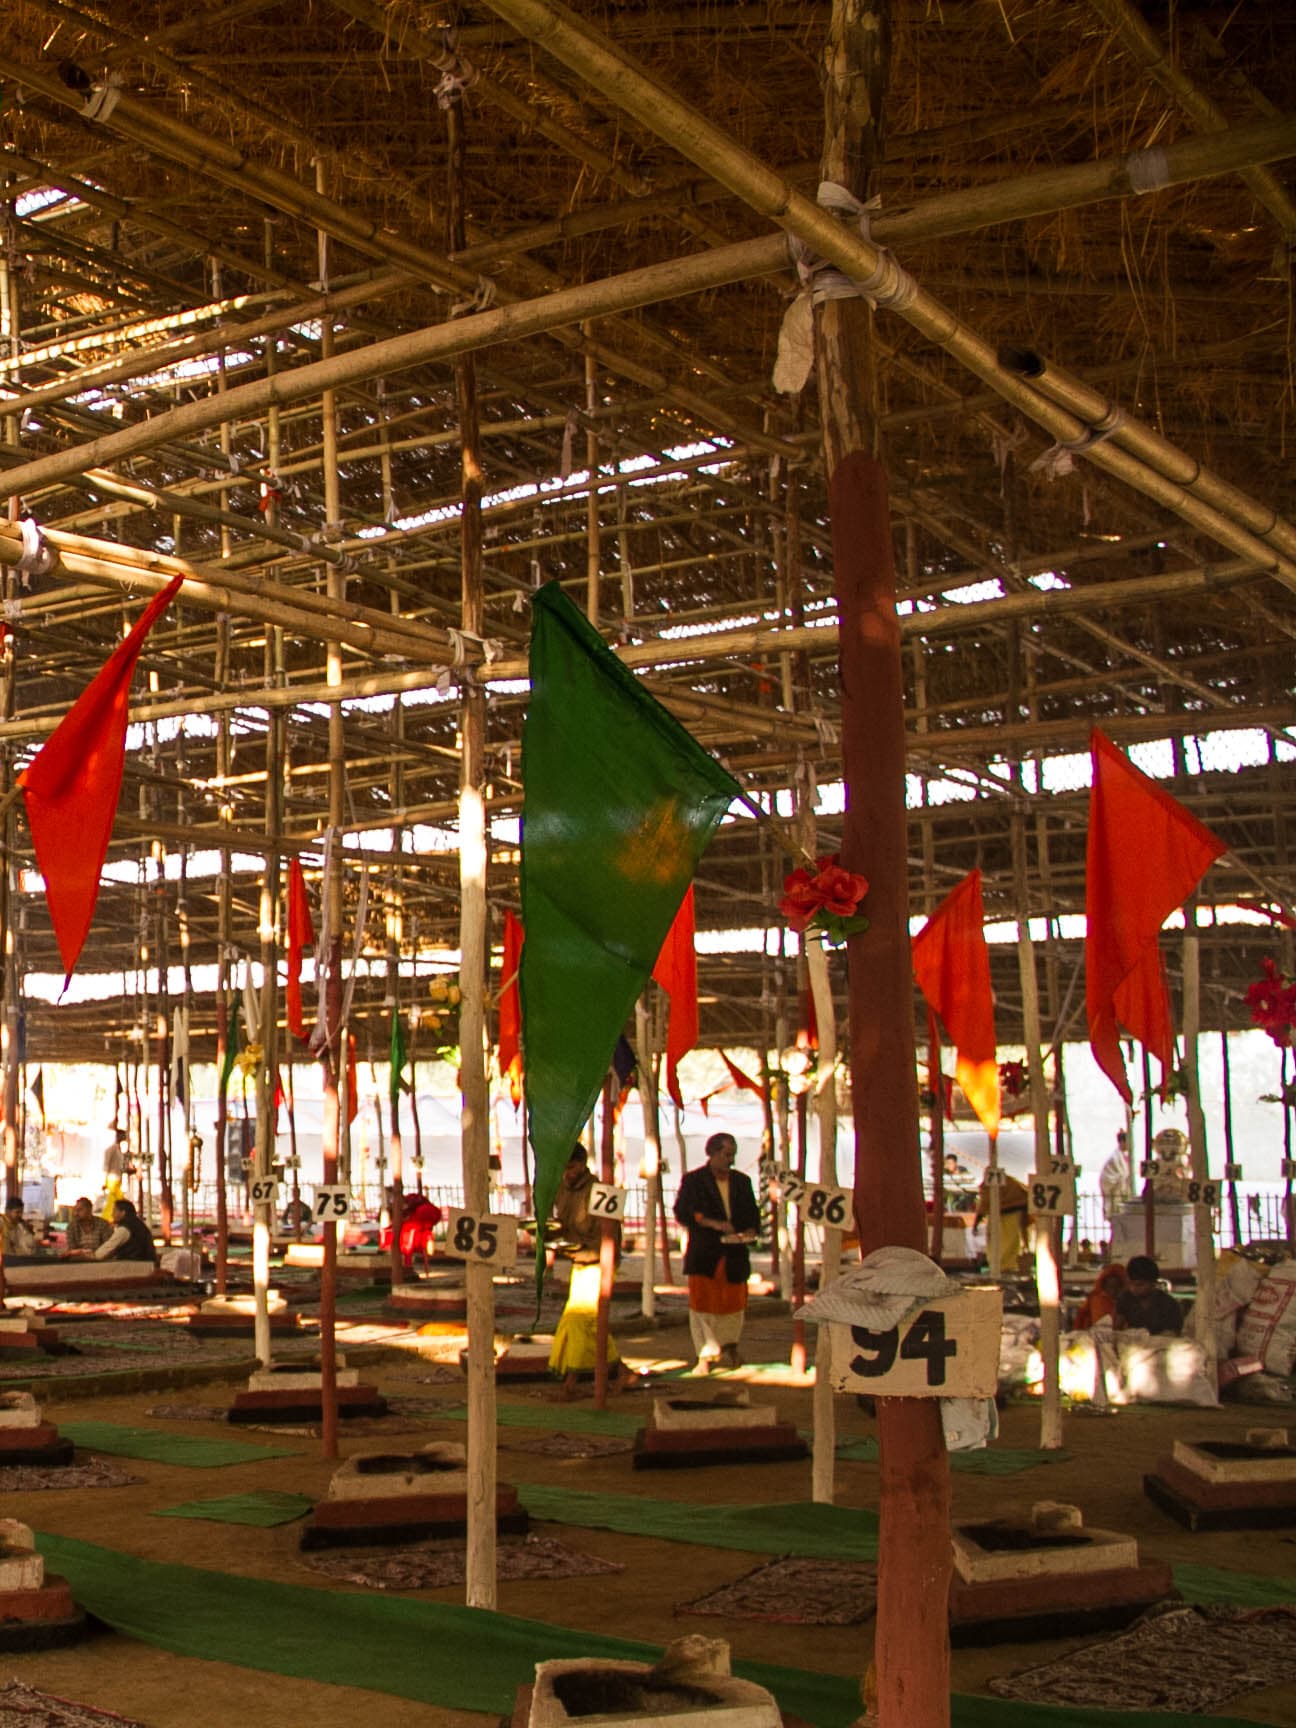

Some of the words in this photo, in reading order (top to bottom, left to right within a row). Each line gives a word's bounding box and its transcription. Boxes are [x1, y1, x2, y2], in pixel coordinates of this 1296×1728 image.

[252, 1182, 274, 1199] 67
[592, 1191, 618, 1213] 76
[1032, 1183, 1061, 1210] 87
[1188, 1182, 1216, 1204] 88
[317, 1193, 348, 1216] 75
[808, 1190, 846, 1223] 86
[454, 1216, 498, 1258] 85
[849, 1310, 957, 1386] 94
